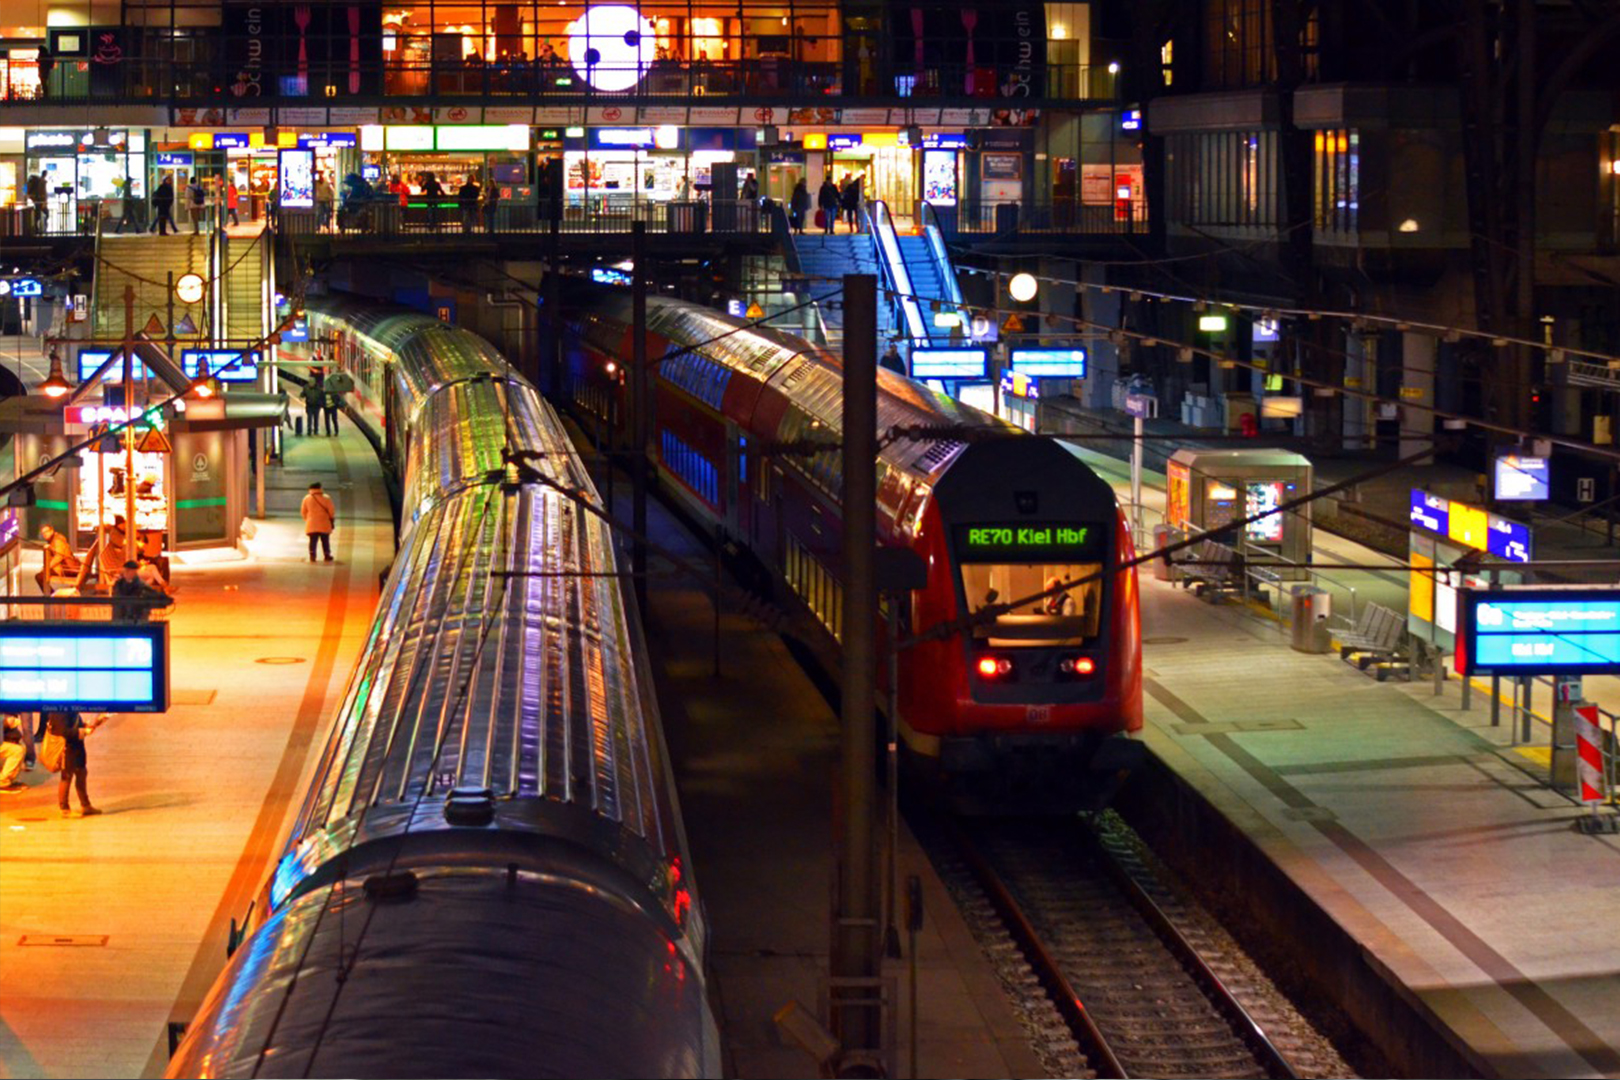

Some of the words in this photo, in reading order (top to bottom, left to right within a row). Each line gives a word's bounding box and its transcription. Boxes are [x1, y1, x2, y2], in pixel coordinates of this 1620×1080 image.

[242, 6, 262, 98] Schwein
[1011, 10, 1032, 98] Schwein
[76, 297, 86, 311] H
[728, 299, 741, 316] E
[1579, 480, 1593, 500] H
[968, 528, 1013, 546] RE70
[1017, 528, 1052, 545] Kiel
[1055, 527, 1089, 545] Hbf
